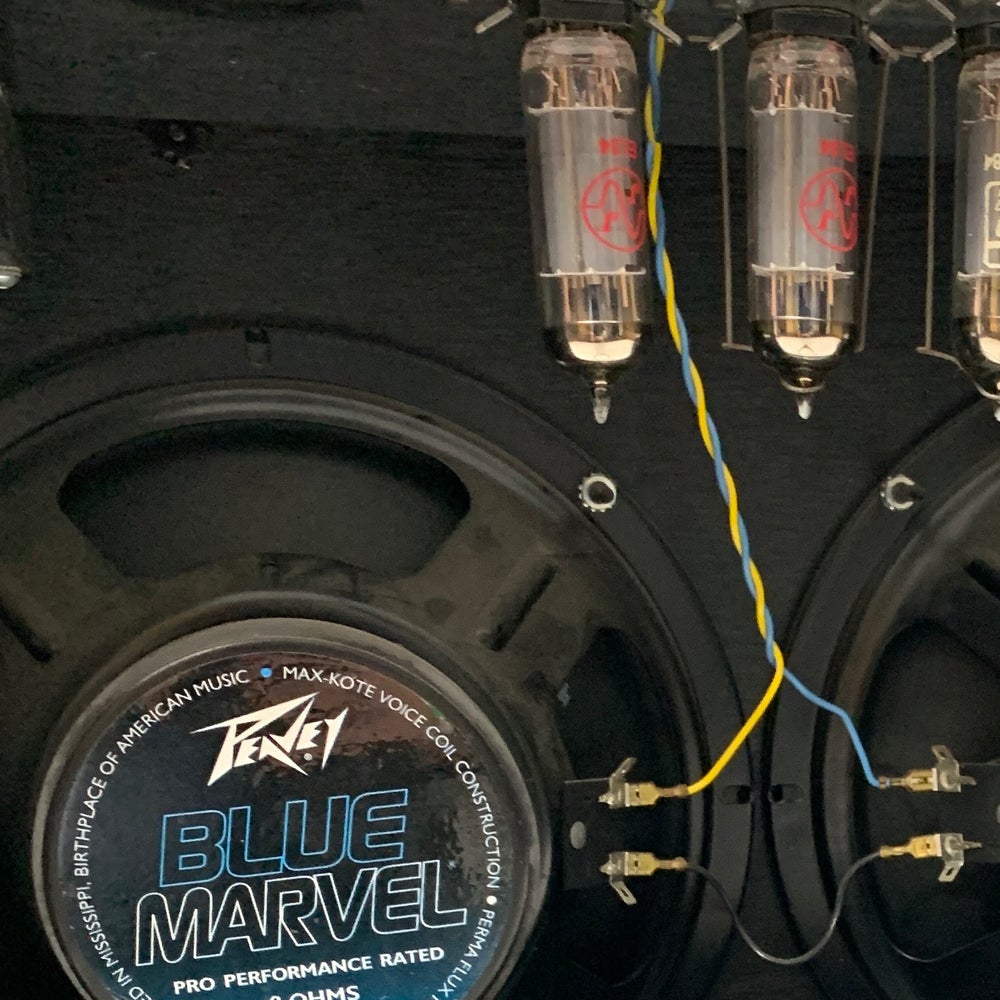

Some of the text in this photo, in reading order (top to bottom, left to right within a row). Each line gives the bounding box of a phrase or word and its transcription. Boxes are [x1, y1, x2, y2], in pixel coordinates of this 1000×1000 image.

[74, 669, 250, 876] BIRTHPLACE OF AMERICAN MUSIC
[283, 666, 500, 889] MAX-KOTE VOICE COIL CONSTRUCTION
[159, 788, 409, 888] BLUE
[76, 881, 119, 968] MISSISSIPPI,
[135, 859, 468, 967] MARVEL
[464, 909, 496, 958] PERMA
[112, 967, 132, 988] IN
[173, 946, 445, 995] PRO PERFORMANCE RATED
[438, 959, 472, 997] FLUX
